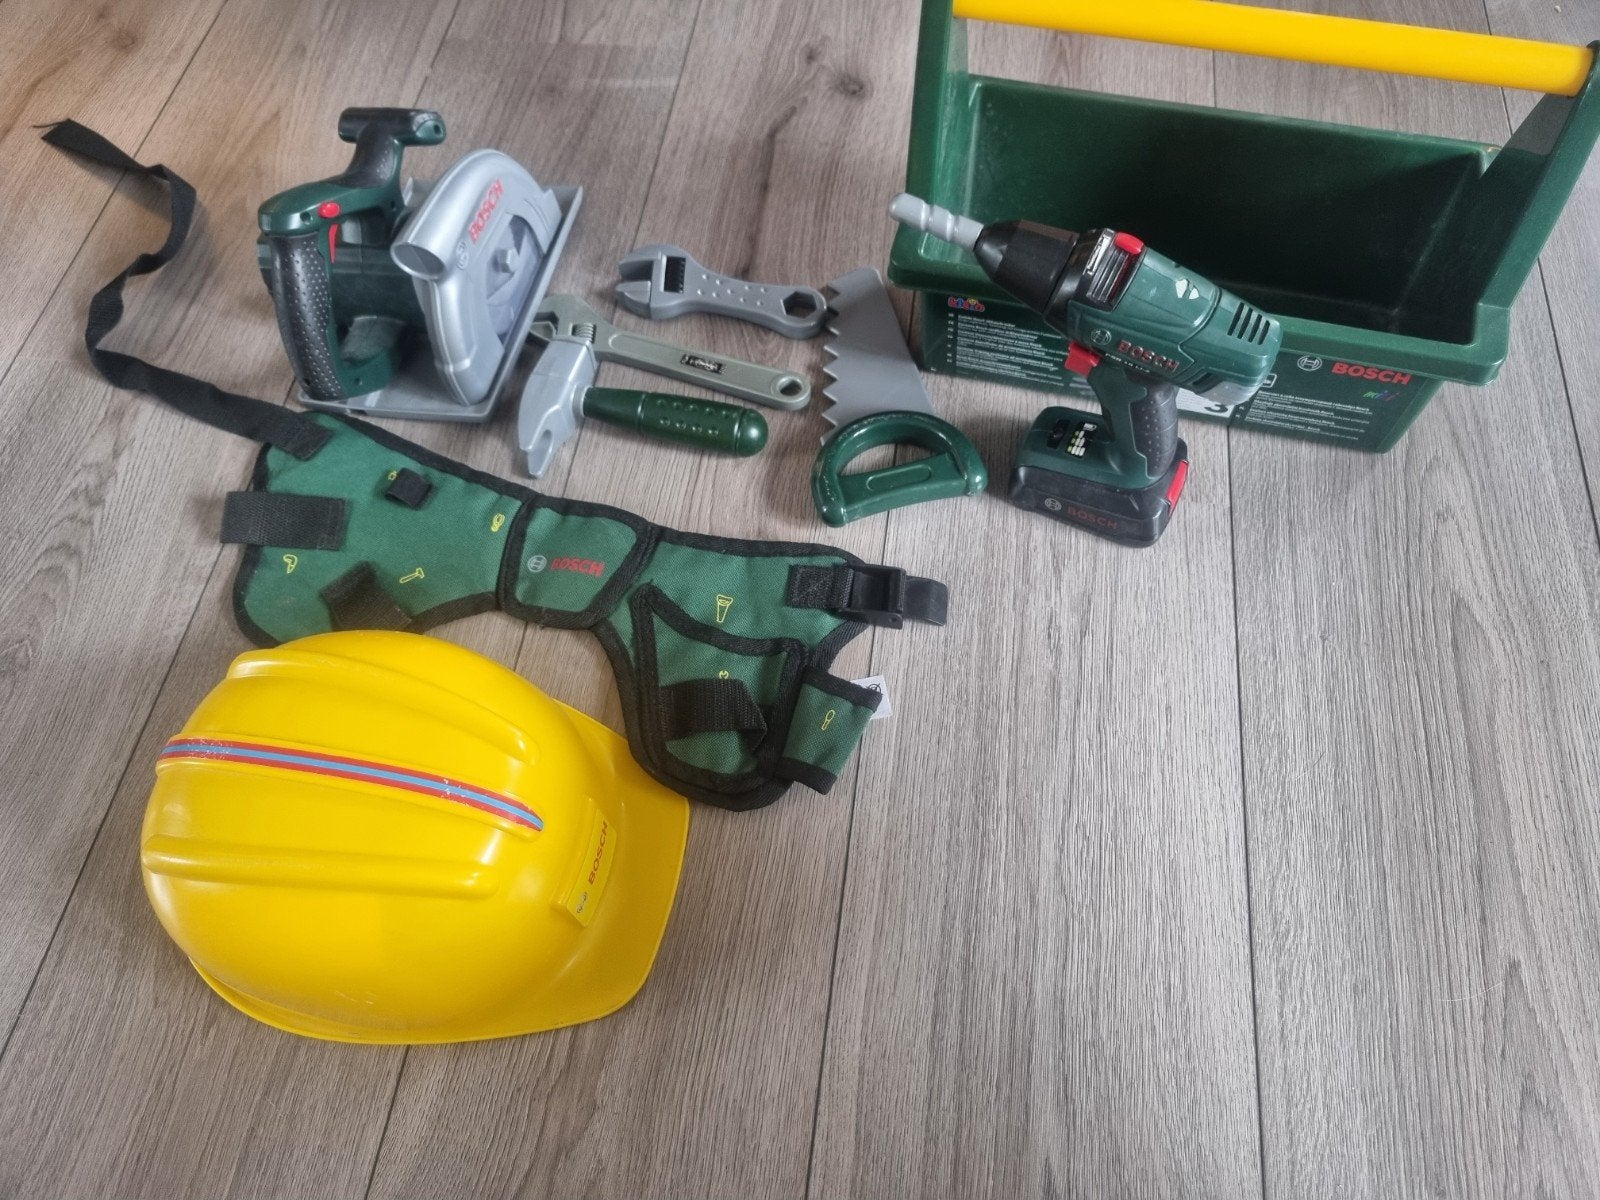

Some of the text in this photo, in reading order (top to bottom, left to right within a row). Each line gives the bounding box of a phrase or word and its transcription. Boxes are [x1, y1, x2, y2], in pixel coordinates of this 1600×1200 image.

[469, 177, 503, 245] BOSCH
[1119, 340, 1180, 372] BOSCH
[1331, 362, 1411, 385] BOSCH
[1067, 506, 1117, 529] BOSCH
[551, 556, 605, 577] BOSCH
[588, 820, 608, 886] BOSCH
